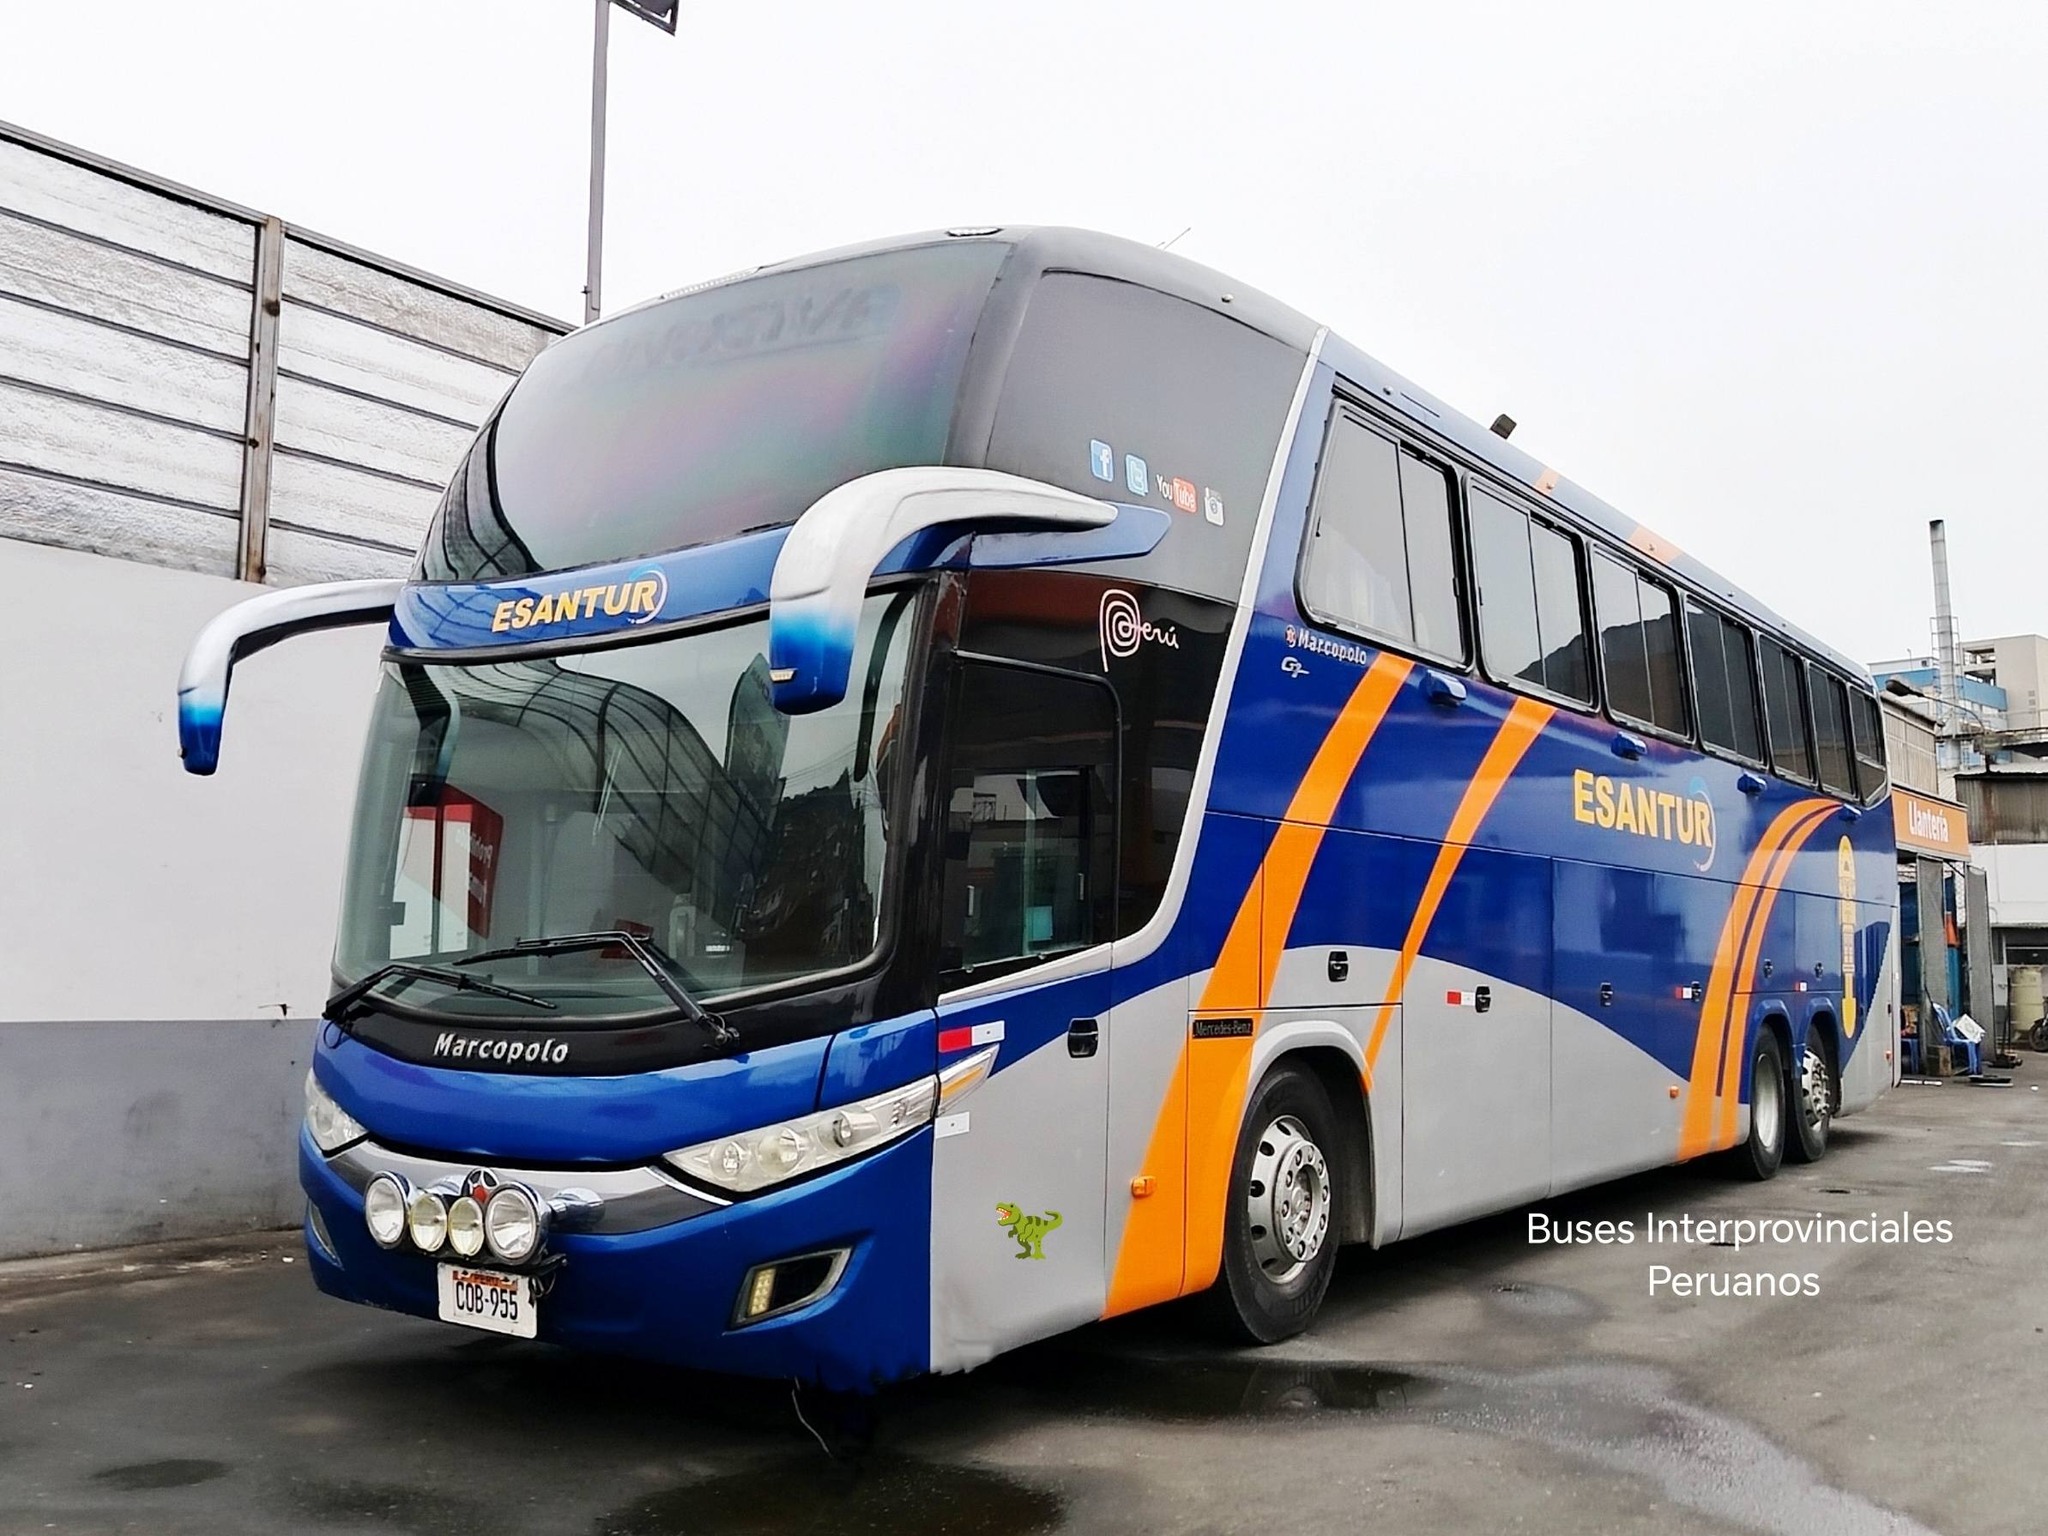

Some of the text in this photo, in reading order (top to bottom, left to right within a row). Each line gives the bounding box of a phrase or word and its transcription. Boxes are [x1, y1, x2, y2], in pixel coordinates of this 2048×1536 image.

[491, 580, 658, 633] ESANTUR
[1298, 628, 1368, 665] Marcopolo
[1573, 768, 1713, 848] ESANTUR
[1908, 800, 1948, 843] Llantería
[433, 1032, 569, 1064] Marcopolo
